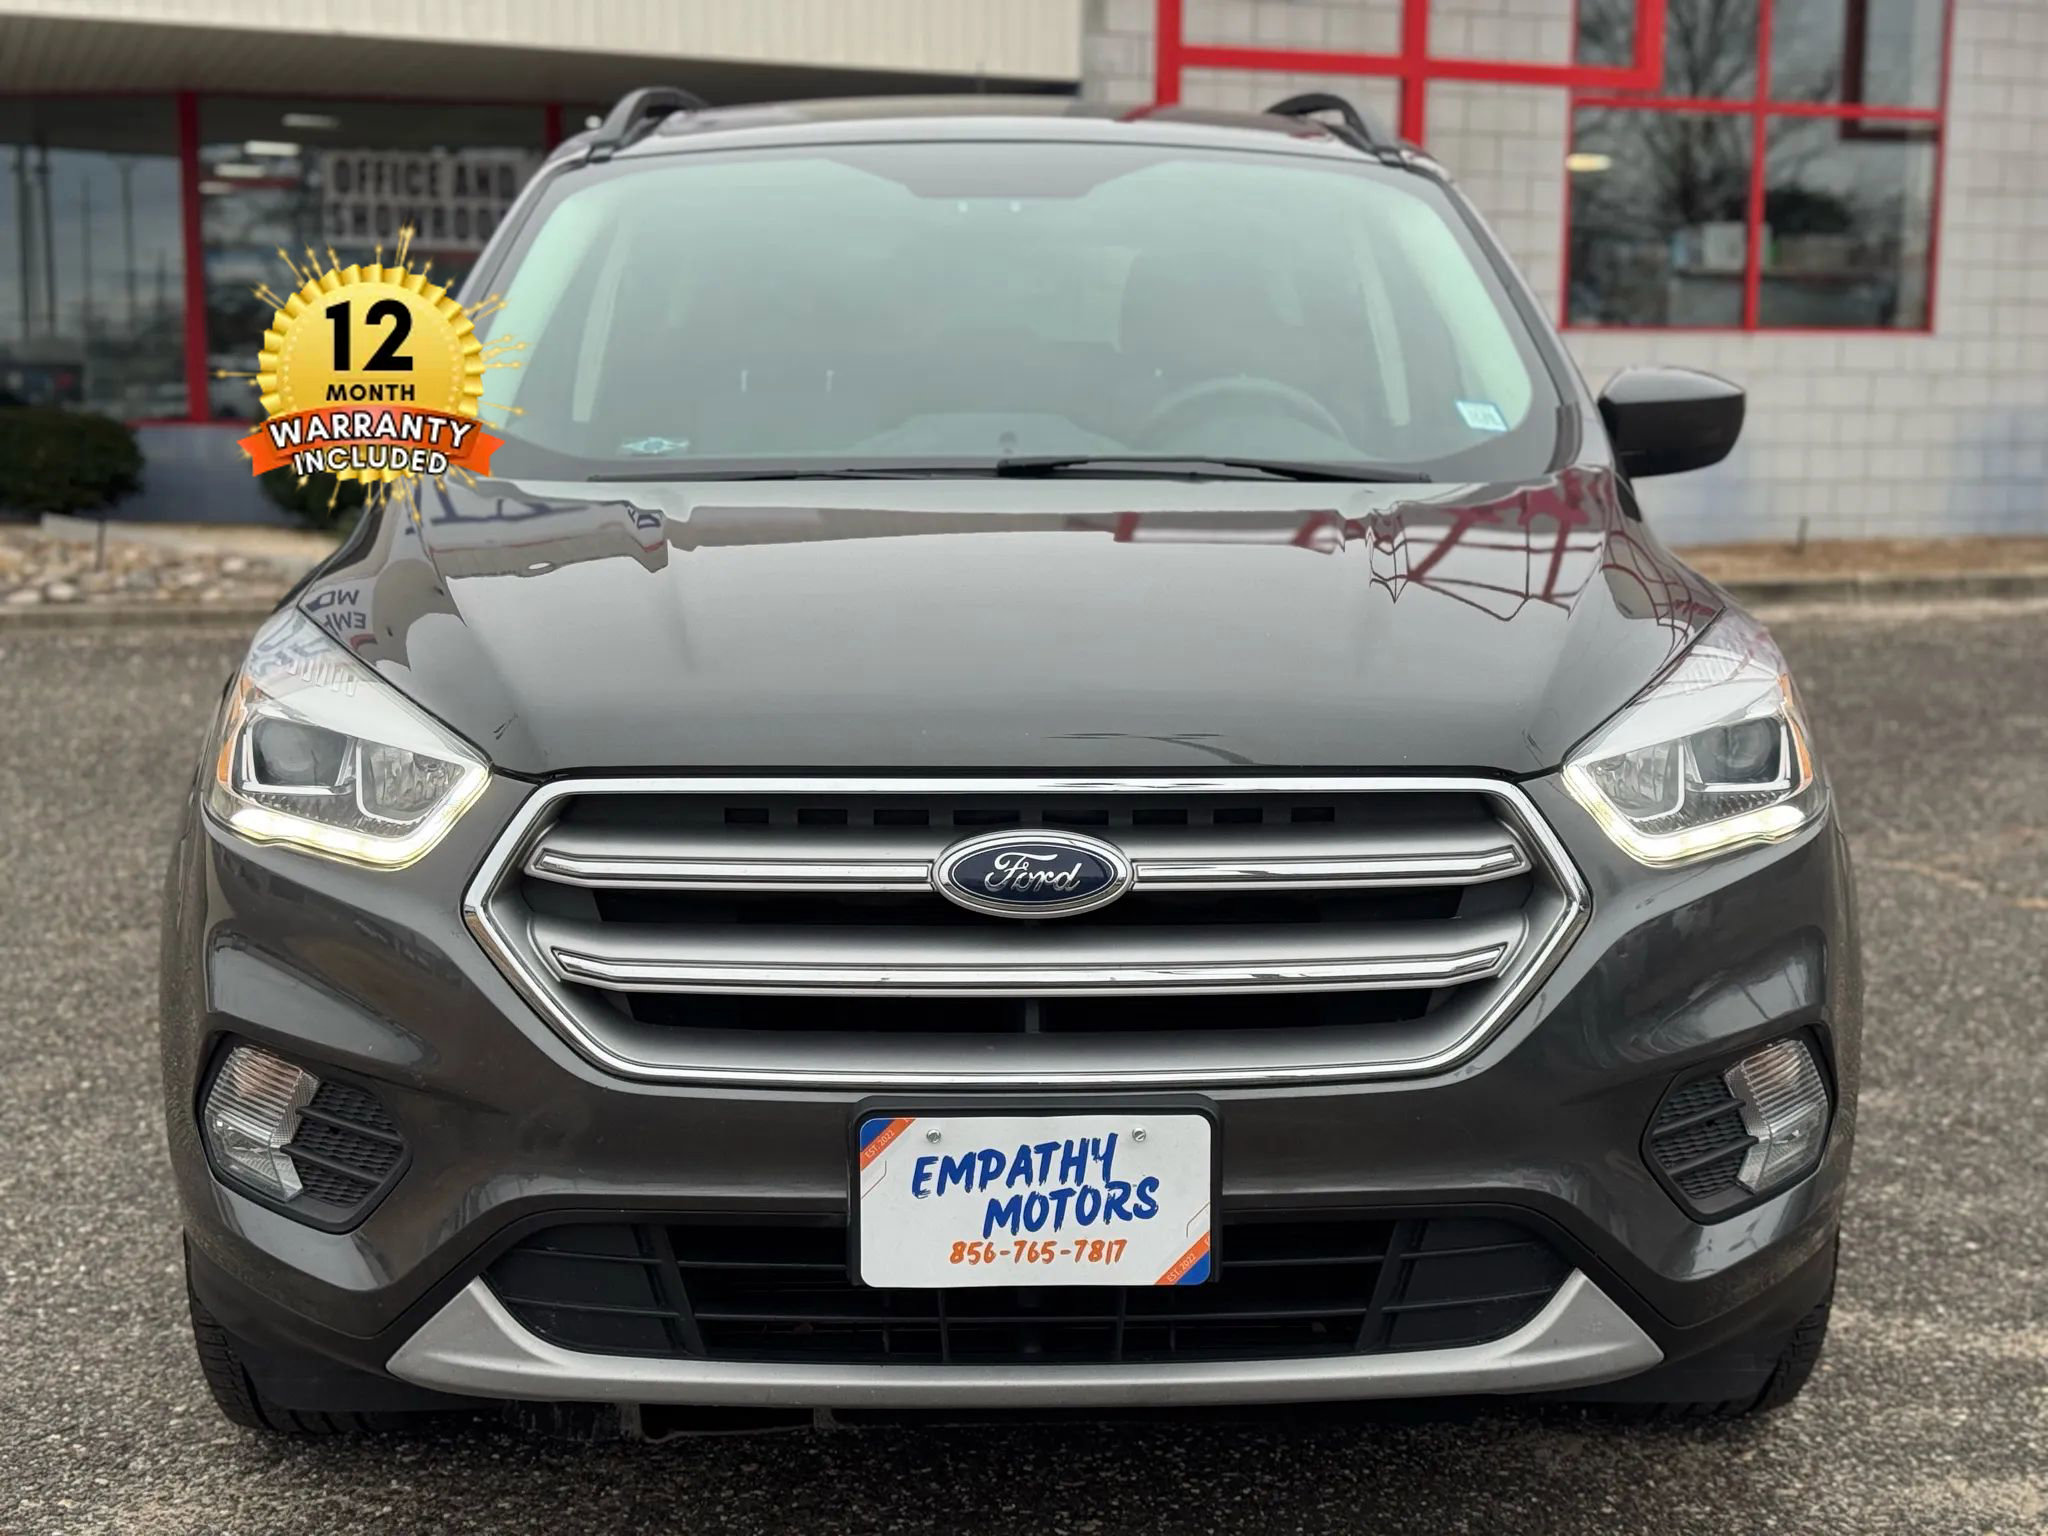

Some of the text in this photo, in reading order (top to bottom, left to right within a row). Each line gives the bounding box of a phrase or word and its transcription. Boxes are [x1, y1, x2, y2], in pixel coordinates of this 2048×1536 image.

[334, 158, 517, 199] OFFICE AND
[331, 201, 506, 242] SHOWROO
[984, 852, 1083, 892] Ford
[911, 1132, 1119, 1200] EMPATHY
[982, 1175, 1160, 1240] MOTORS
[949, 1239, 1128, 1265] 856-765-7817
